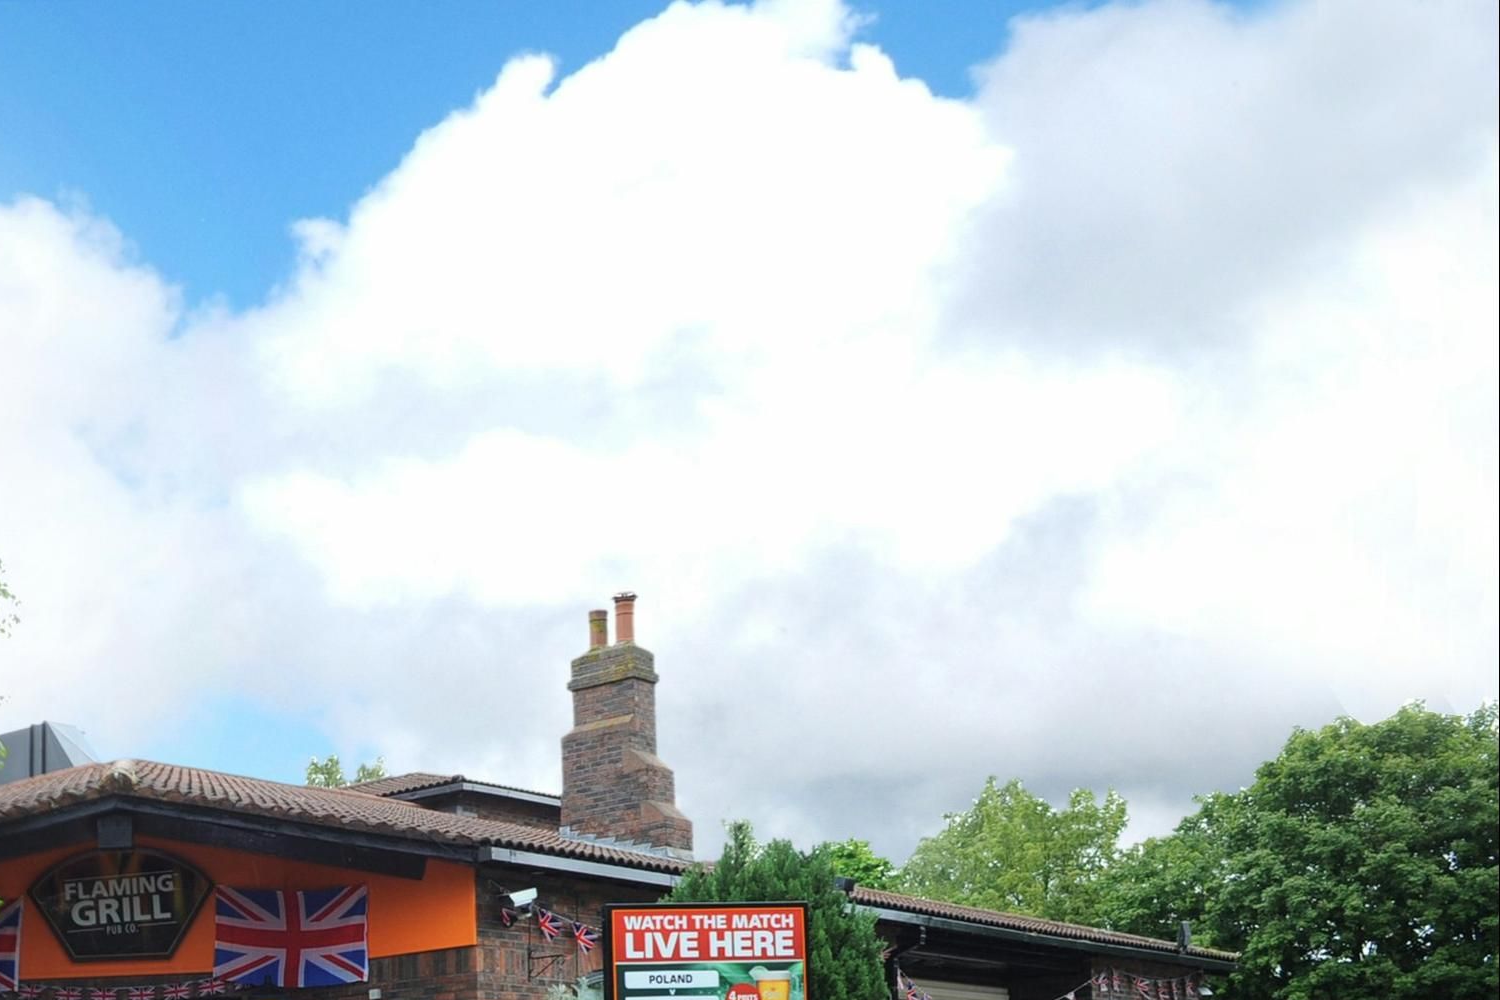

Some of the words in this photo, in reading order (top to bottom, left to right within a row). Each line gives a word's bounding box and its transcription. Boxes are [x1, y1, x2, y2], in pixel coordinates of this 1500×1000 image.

[64, 873, 176, 901] FLAMING
[71, 894, 171, 926] GRILL
[106, 925, 122, 935] PUB
[624, 915, 687, 931] WATCH
[692, 914, 727, 929] THE
[732, 914, 794, 929] MATCH
[625, 931, 699, 959] LIVE
[709, 930, 795, 958] HERE
[649, 974, 693, 984] POLAND
